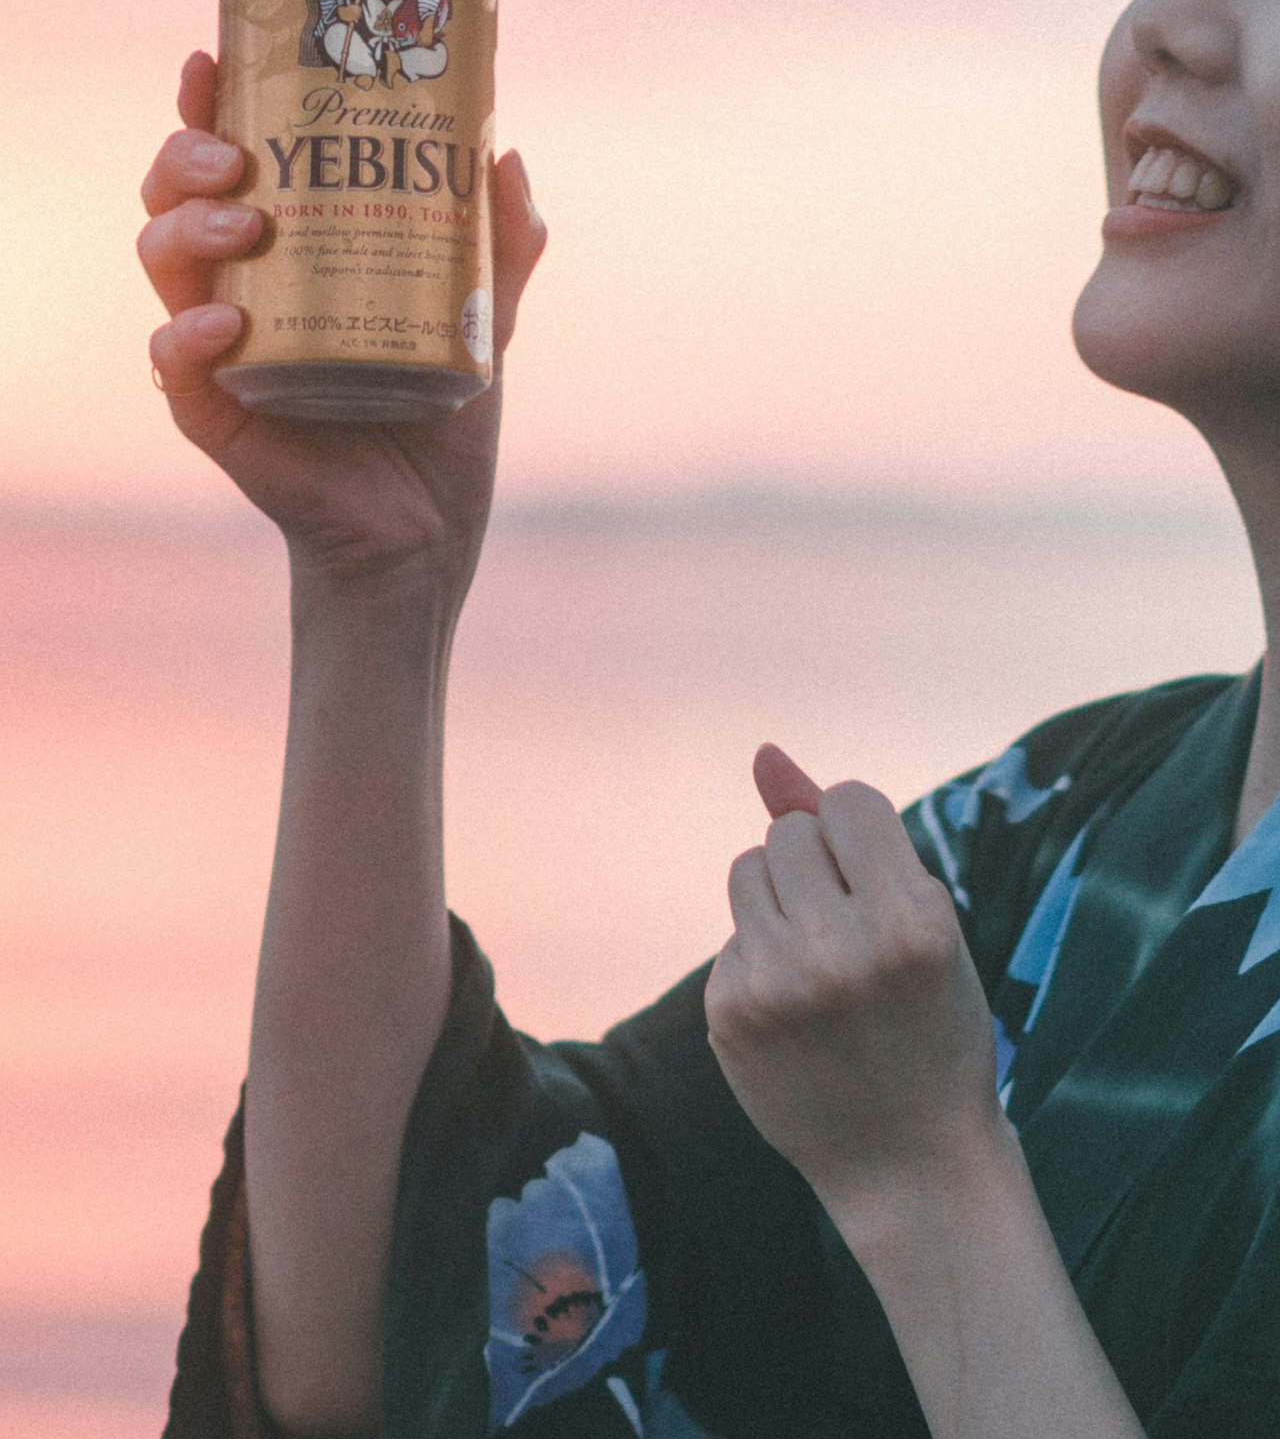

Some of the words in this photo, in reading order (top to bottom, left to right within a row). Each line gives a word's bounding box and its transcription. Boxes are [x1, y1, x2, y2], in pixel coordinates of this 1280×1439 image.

[293, 87, 455, 133] Premium
[265, 135, 477, 199] YEBISU
[273, 204, 324, 218] BORN
[333, 204, 354, 217] IN
[363, 204, 413, 220] 1890,
